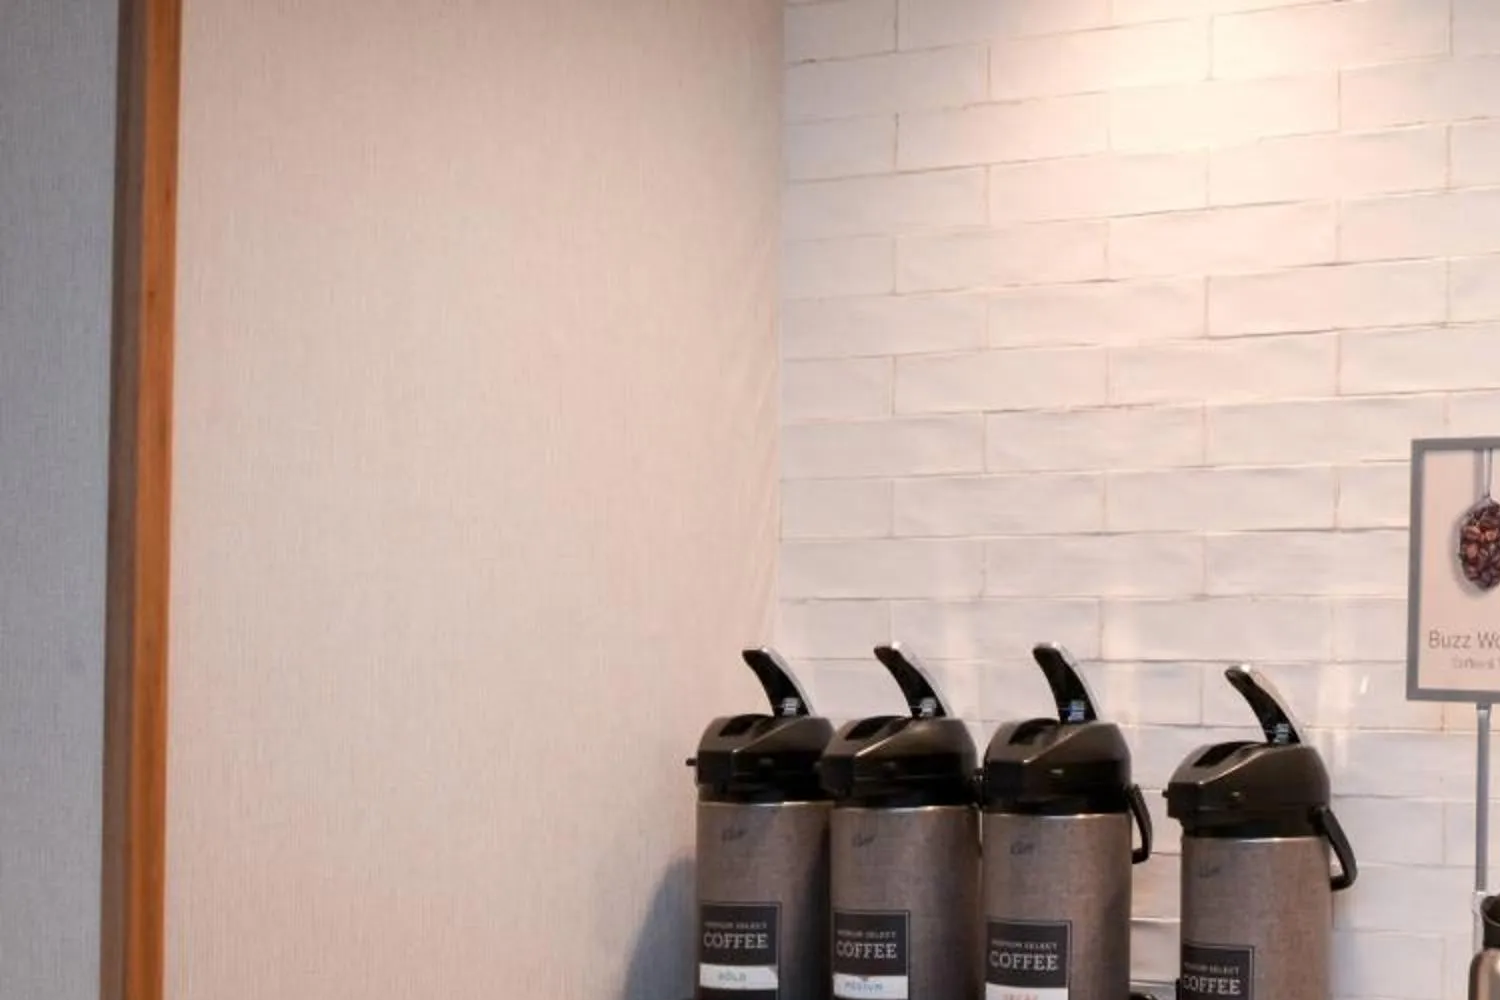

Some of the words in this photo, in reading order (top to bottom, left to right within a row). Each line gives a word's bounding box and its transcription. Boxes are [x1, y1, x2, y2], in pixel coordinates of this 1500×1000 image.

[1428, 629, 1471, 649] Buzz
[703, 932, 769, 949] COFFEE
[836, 940, 897, 959] COFFEE
[989, 950, 1059, 970] COFFEE
[1183, 974, 1241, 995] COFFEE
